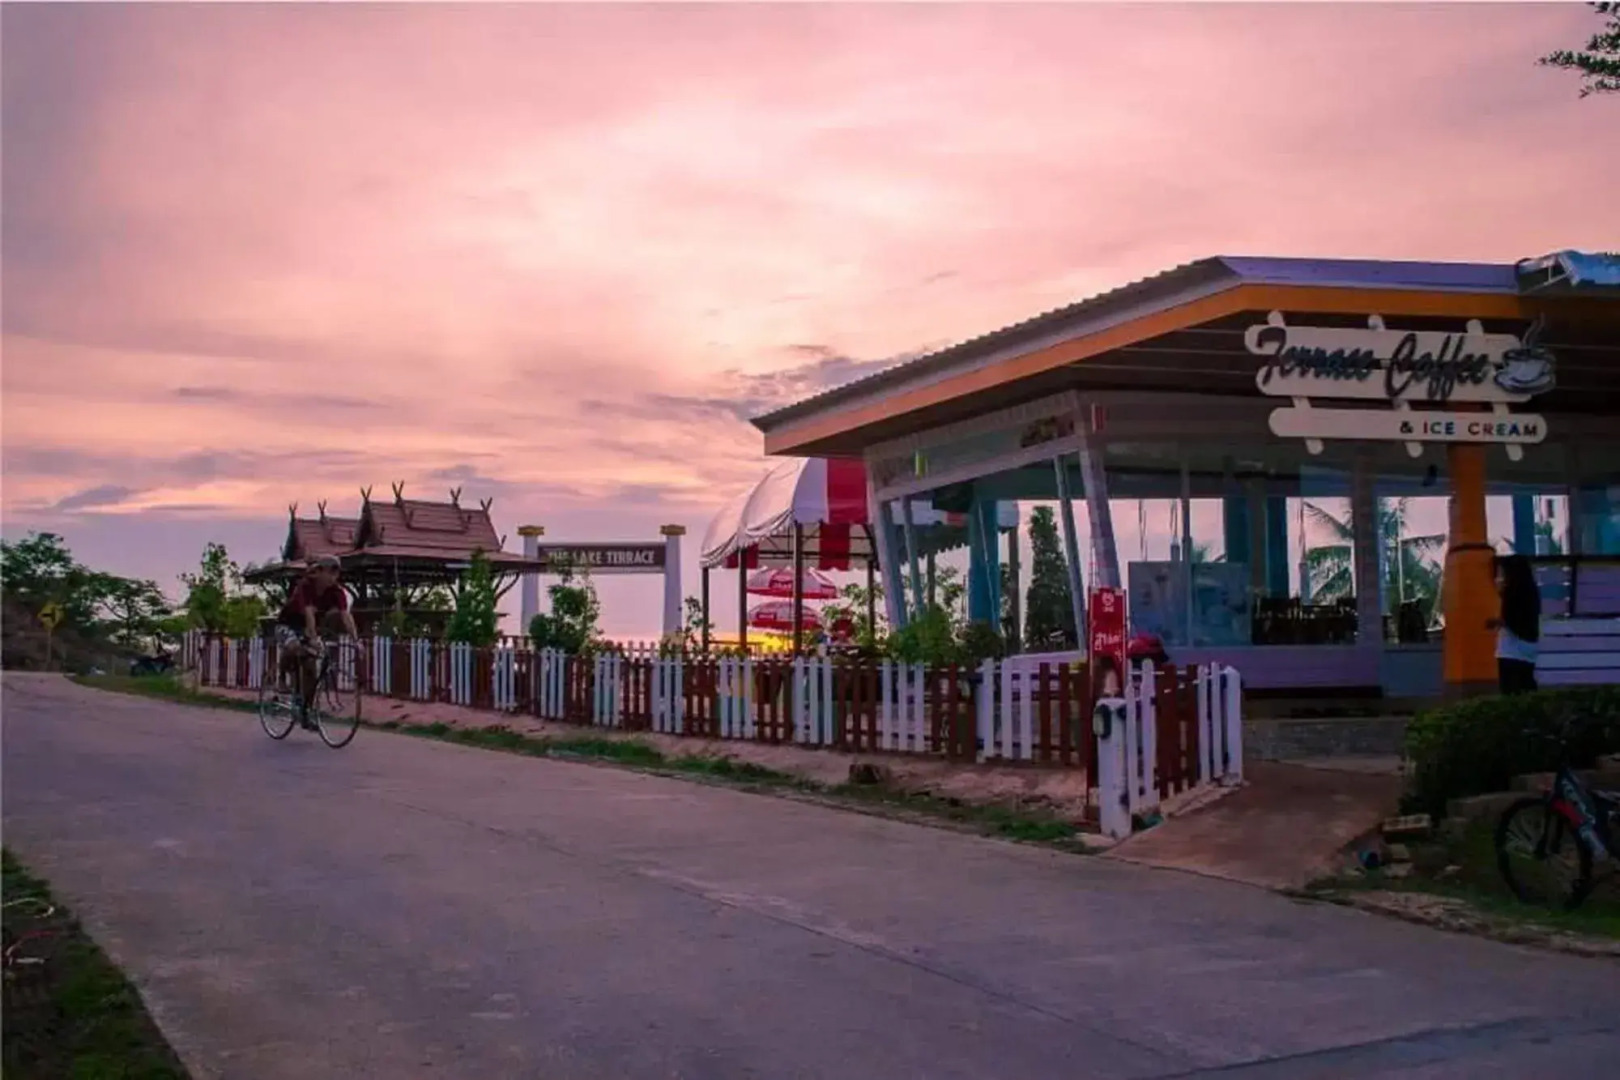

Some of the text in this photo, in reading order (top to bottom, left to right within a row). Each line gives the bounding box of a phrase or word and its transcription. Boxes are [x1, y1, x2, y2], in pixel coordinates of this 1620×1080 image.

[1385, 332, 1490, 399] Coffee
[1399, 421, 1538, 436] & ICE CREAM
[606, 550, 655, 565] TERRACE
